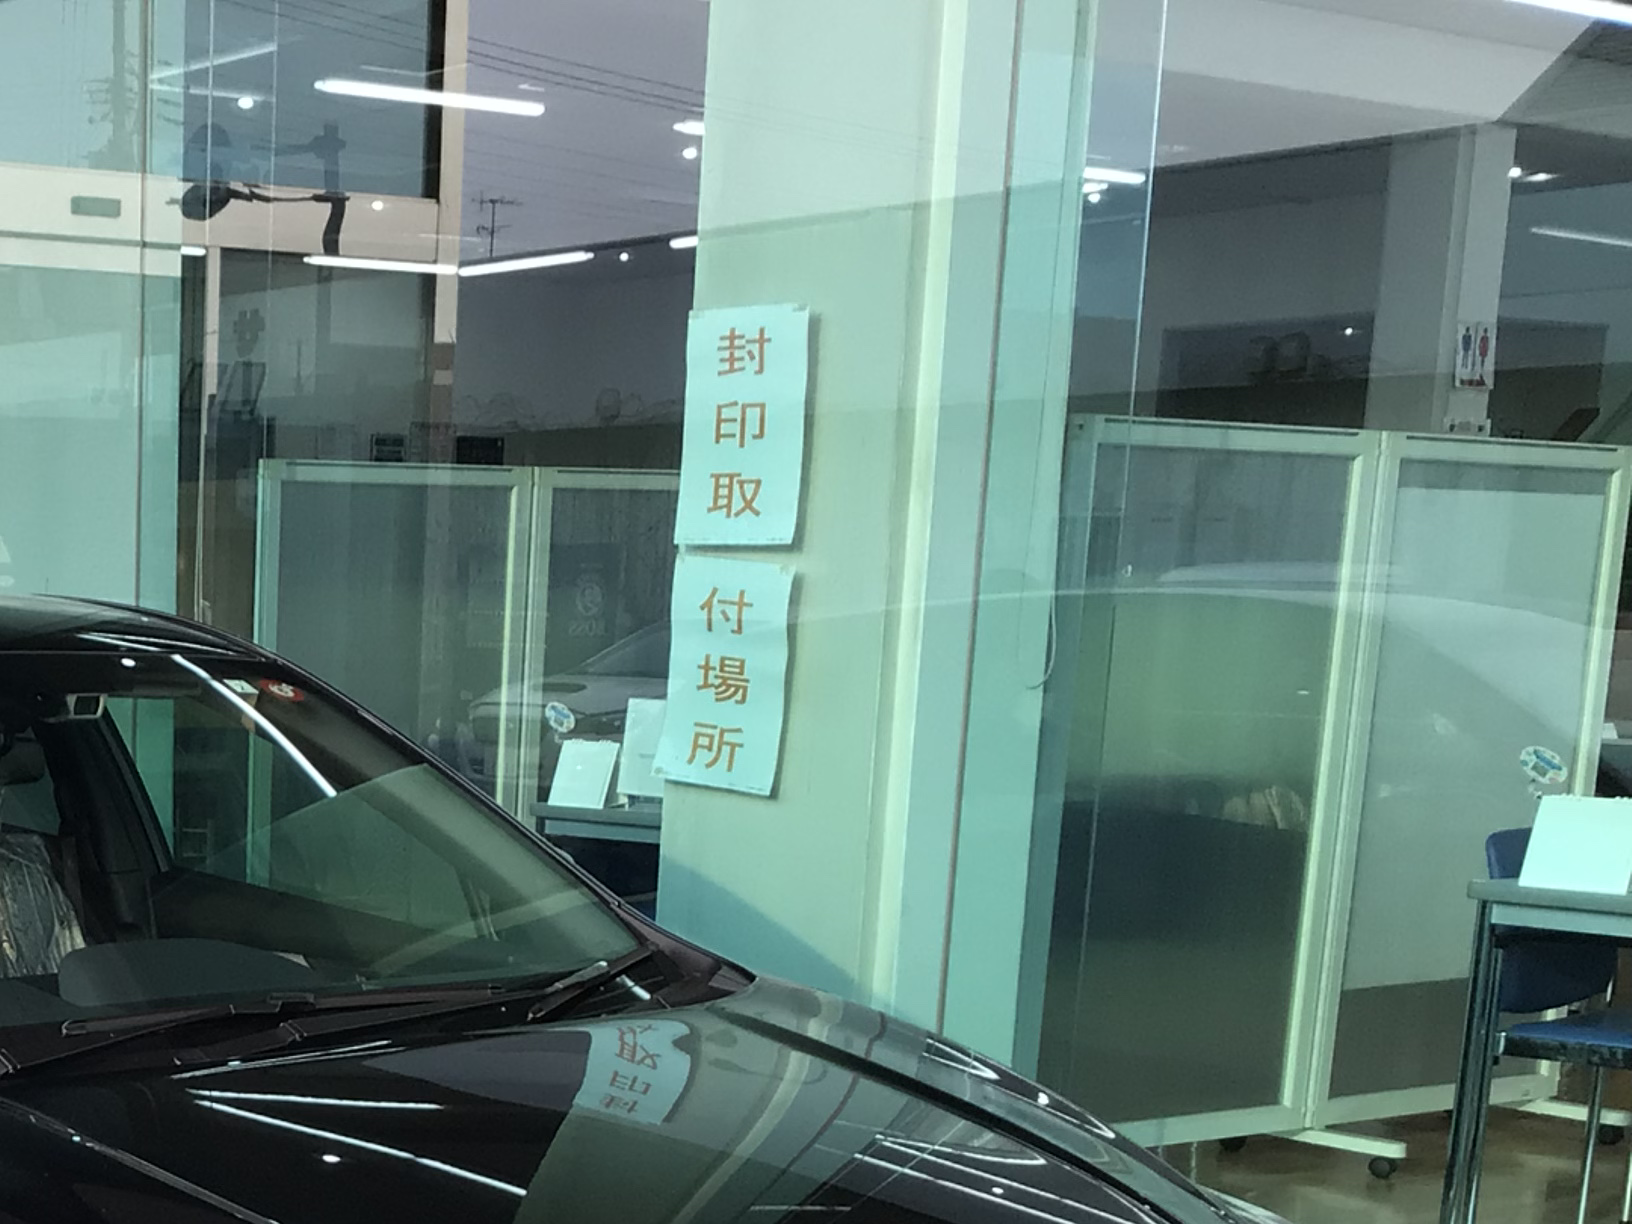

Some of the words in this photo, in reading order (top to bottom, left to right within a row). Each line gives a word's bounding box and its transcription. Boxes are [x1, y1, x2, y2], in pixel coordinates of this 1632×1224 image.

[707, 326, 773, 520] 封印取
[686, 586, 755, 773] 付場所
